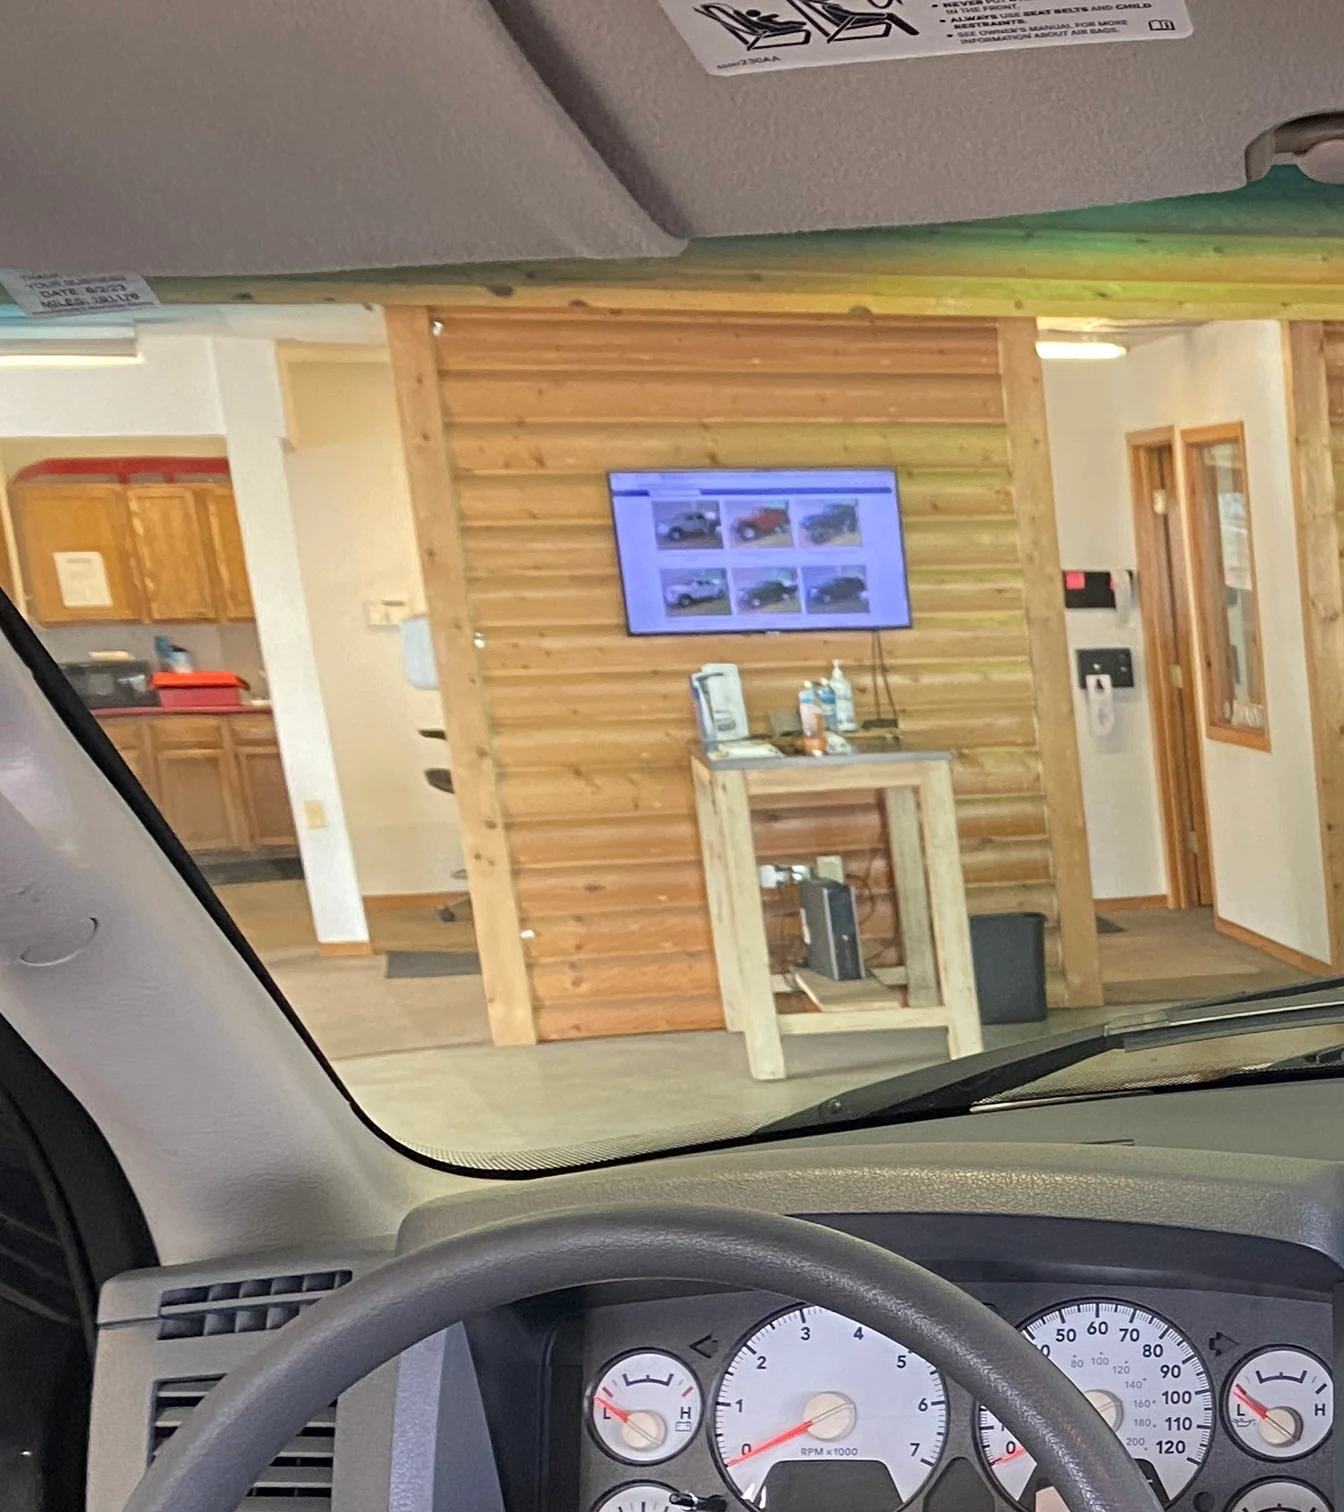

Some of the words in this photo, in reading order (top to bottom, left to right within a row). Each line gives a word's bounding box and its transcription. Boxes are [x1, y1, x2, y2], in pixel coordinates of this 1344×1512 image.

[951, 14, 998, 23] ALWAYS
[1023, 9, 1051, 17] SEAT
[1053, 6, 1089, 14] BELTS
[1091, 4, 1113, 12] AND
[1115, 2, 1152, 10] CHILD
[1029, 23, 1073, 32] MANUAL
[960, 34, 1032, 44] INFORMATION
[1034, 30, 1068, 39] ABOUT
[800, 1327, 811, 1341] 3
[853, 1327, 864, 1340] 4
[1055, 1328, 1076, 1342] 50
[1087, 1321, 1108, 1335] 60
[1119, 1328, 1140, 1342] 70
[1142, 1344, 1163, 1358] 80
[756, 1356, 767, 1370] 2
[896, 1355, 907, 1369] 5
[1070, 1359, 1084, 1369] 80
[1090, 1357, 1109, 1366] 100
[1112, 1365, 1130, 1374] 120
[1160, 1364, 1181, 1378] 90
[1125, 1381, 1143, 1389] 140
[1133, 1399, 1151, 1408] 160
[1162, 1391, 1192, 1404] 100
[735, 1399, 743, 1413] 1
[917, 1398, 928, 1412] 6
[1237, 1404, 1246, 1417] L
[1314, 1403, 1326, 1416] H
[603, 1407, 612, 1420] L
[680, 1406, 692, 1420] H
[1134, 1418, 1151, 1427] 180
[1164, 1417, 1193, 1431] 110
[1005, 1440, 1016, 1454] 0
[1126, 1437, 1145, 1446] 200
[1155, 1440, 1186, 1454] 120
[800, 1447, 824, 1457] RPM
[909, 1442, 921, 1457] 7
